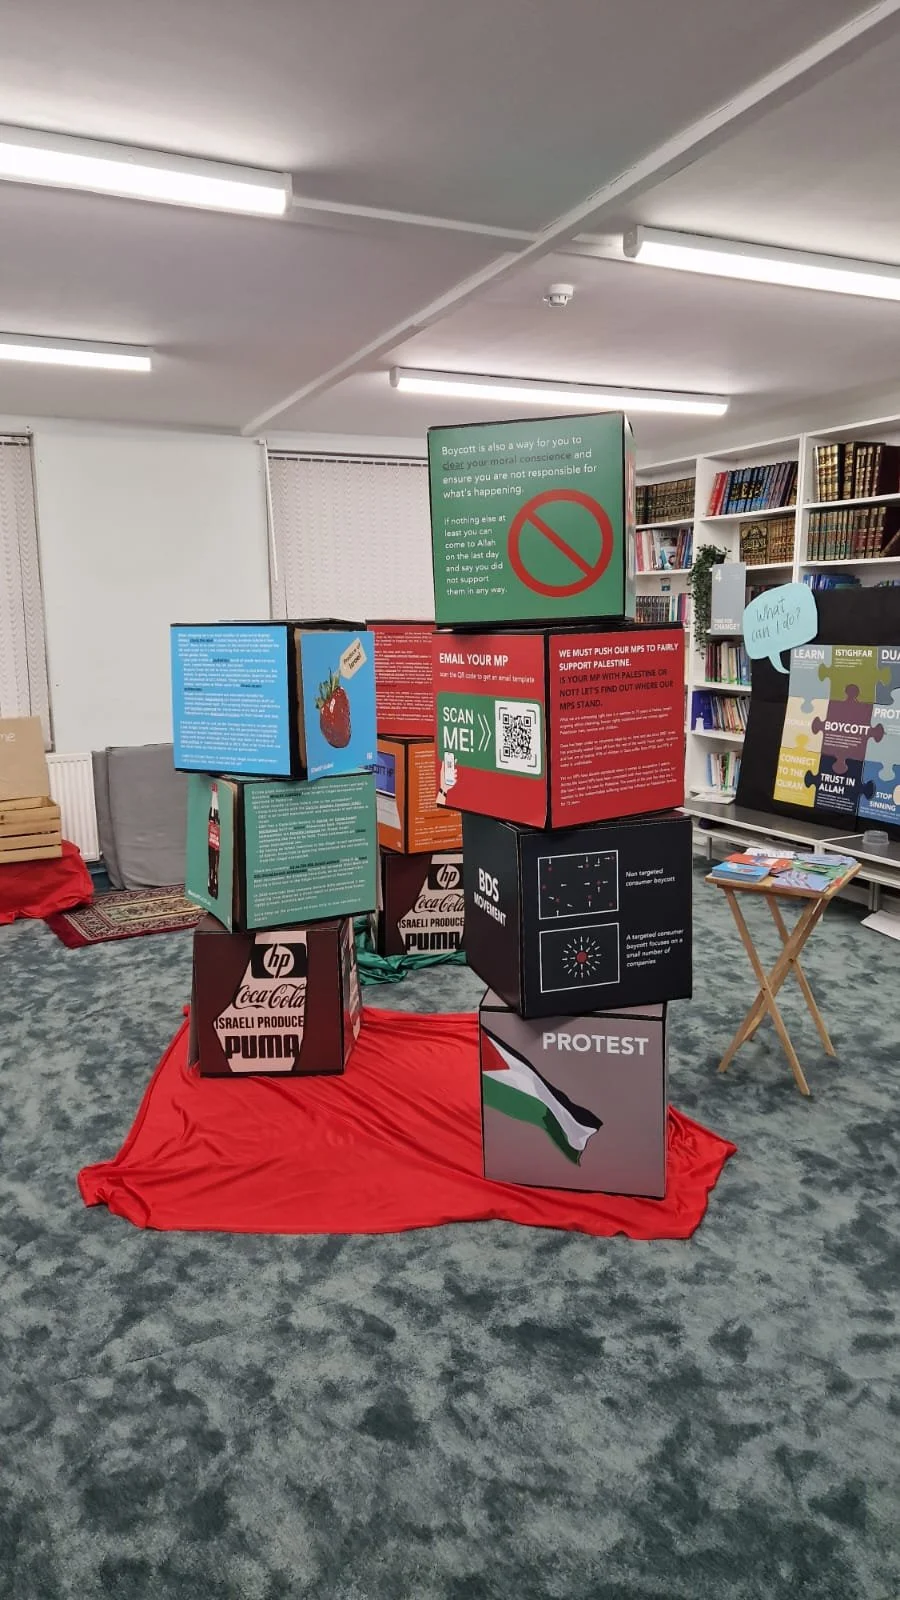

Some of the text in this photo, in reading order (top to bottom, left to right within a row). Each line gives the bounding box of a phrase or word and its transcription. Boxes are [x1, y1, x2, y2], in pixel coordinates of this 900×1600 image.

[442, 436, 582, 457] Boycott is also a way for you to
[442, 447, 592, 471] clear your moral conscience and
[442, 463, 598, 485] ensure you are not responsible for
[443, 485, 525, 499] what's happening.
[451, 515, 480, 525] nothing
[481, 515, 497, 523] else
[498, 514, 506, 522] at
[444, 529, 462, 537] least
[463, 529, 478, 538] you
[467, 541, 476, 549] to
[477, 538, 496, 547] Allah
[445, 549, 500, 561] on the last day
[445, 561, 504, 573] and say you did
[446, 575, 490, 585] not support
[714, 568, 723, 583] 4
[446, 586, 508, 596] them in any way.
[756, 598, 786, 623] What
[751, 625, 771, 642] can
[782, 607, 801, 631] do?
[558, 642, 679, 658] WE MUST PUSH OUR MPS TO FAIRLY
[793, 648, 825, 660] LEARN
[835, 648, 873, 658] ISTIGHFAR
[439, 652, 509, 667] EMAIL YOUR MP
[559, 658, 632, 672] SUPPORT PALESTINE.
[457, 671, 465, 679] QR
[483, 674, 491, 682] get
[498, 674, 512, 682] email
[512, 675, 535, 684] template
[559, 668, 668, 685] IS YOUR MP WITH PALESTINE OR
[559, 680, 674, 697] NOT? LET'S FIND OUT WHERE OUR
[559, 699, 603, 711] MPS STAND.
[443, 706, 474, 725] SCAN
[824, 720, 871, 736] BOYCOTT
[443, 725, 474, 753] ME!
[820, 772, 856, 788] TRUST IN
[818, 783, 845, 795] ALLAH
[876, 791, 893, 800] STOP
[869, 800, 897, 812] SINNING
[440, 864, 458, 890] hp
[639, 867, 664, 877] targeted
[478, 867, 500, 903] BDS
[625, 876, 676, 887] consumer boycott
[473, 891, 507, 927] MOVEMENT
[399, 917, 465, 929] ISRAELI PRODUCE
[405, 932, 461, 951] PUMA
[632, 931, 657, 941] targeted
[657, 929, 684, 937] consumer
[625, 941, 649, 950] boycott
[649, 939, 670, 947] focuses
[267, 943, 291, 978] hp
[626, 950, 641, 959] small
[641, 948, 663, 957] number
[626, 959, 657, 968] companies
[215, 1015, 305, 1030] ISRAELI PRODUCE
[224, 1034, 300, 1059] PUMA
[542, 1032, 649, 1056] PROTEST
